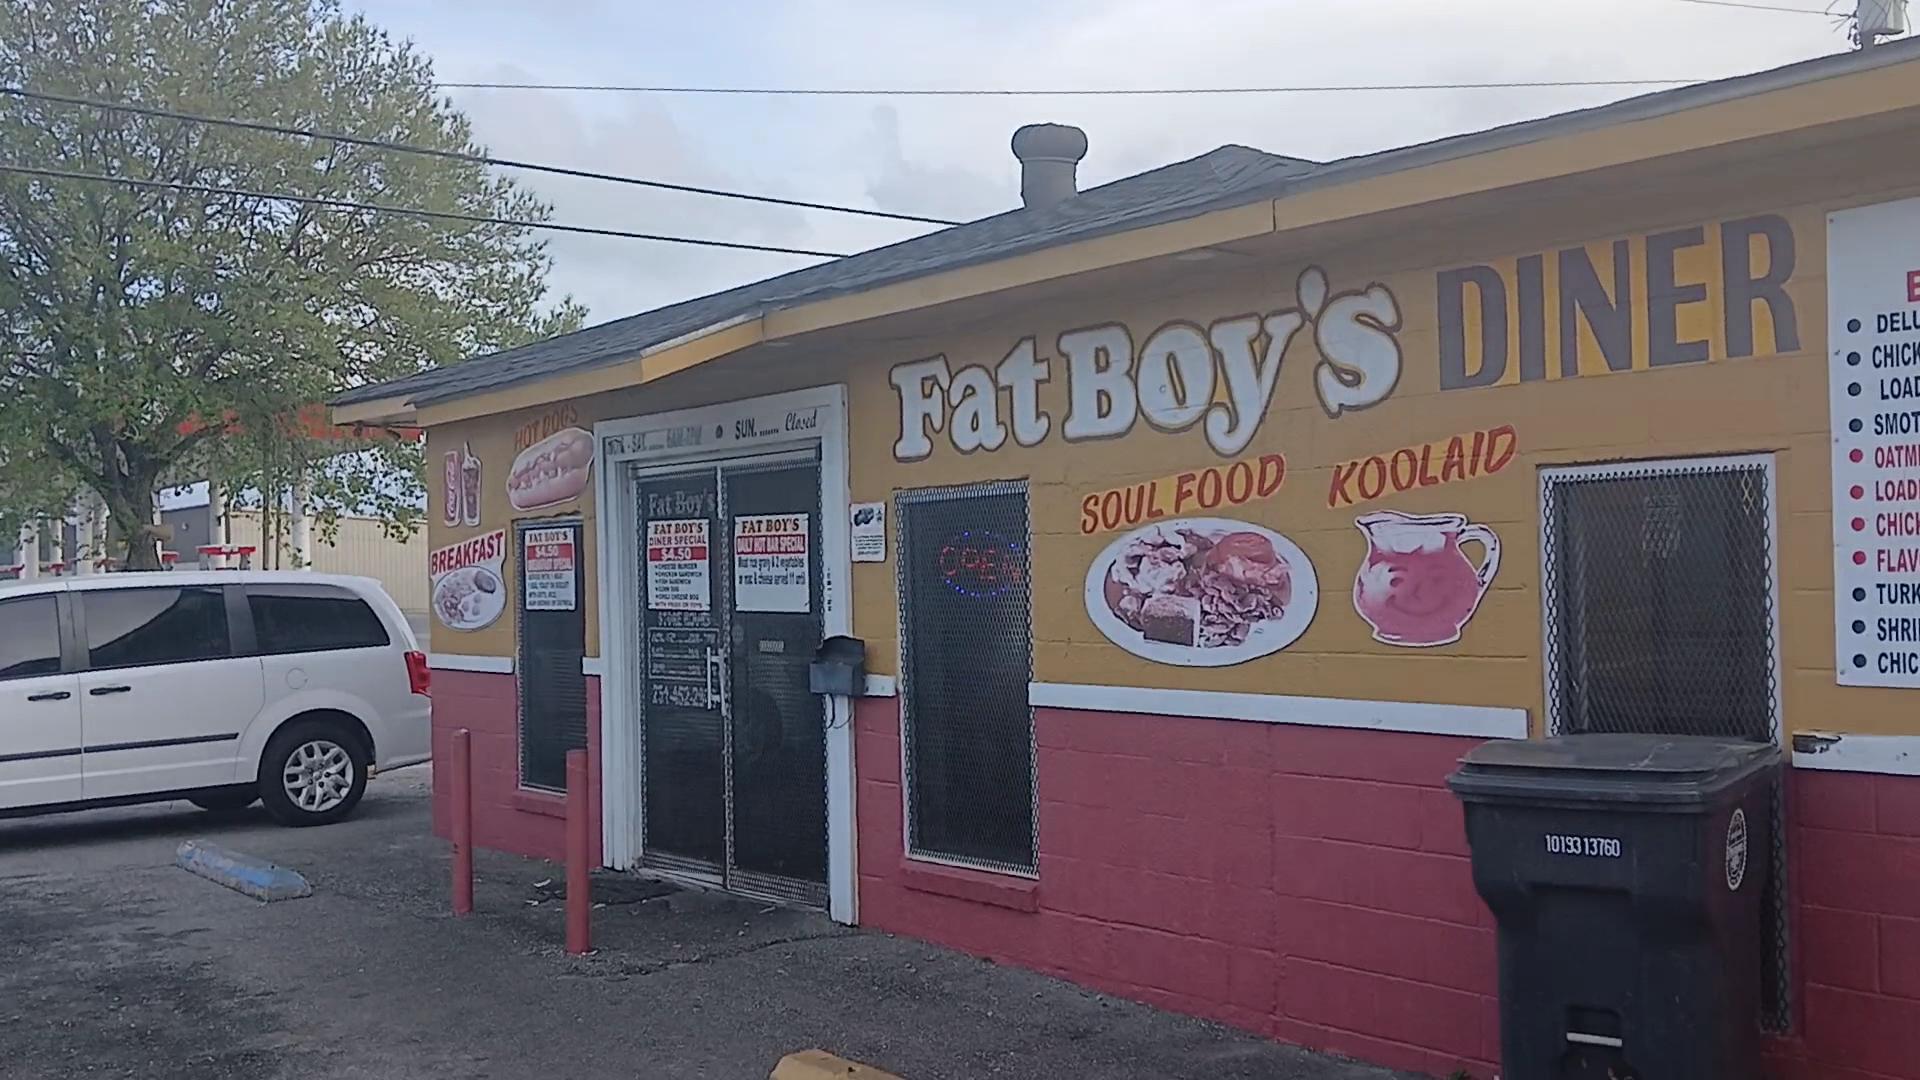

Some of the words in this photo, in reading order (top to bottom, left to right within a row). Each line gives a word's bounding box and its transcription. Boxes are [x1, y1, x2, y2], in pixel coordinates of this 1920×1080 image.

[1437, 214, 1801, 392] DINER
[890, 336, 1051, 463] Fat
[785, 408, 817, 432] Closed
[1329, 424, 1516, 508] KOOLAID
[1874, 444, 1920, 469] OATM
[1081, 482, 1164, 534] SOUL
[1174, 454, 1286, 513] FOOD
[1875, 479, 1920, 502] LOAD
[654, 524, 673, 535] FAT
[675, 523, 703, 534] BOY'S
[742, 520, 763, 533] FAT
[766, 518, 800, 533] BOY'S
[650, 537, 673, 546] DINER
[675, 535, 707, 545] SPECIAL
[431, 531, 504, 576] BREAKFAST
[661, 547, 692, 560] $4.50
[1877, 548, 1920, 573] FLAV
[1876, 583, 1920, 605] TURK
[1877, 617, 1920, 642] SHRI
[1545, 834, 1582, 855] 10193
[1583, 837, 1621, 857] 13760
